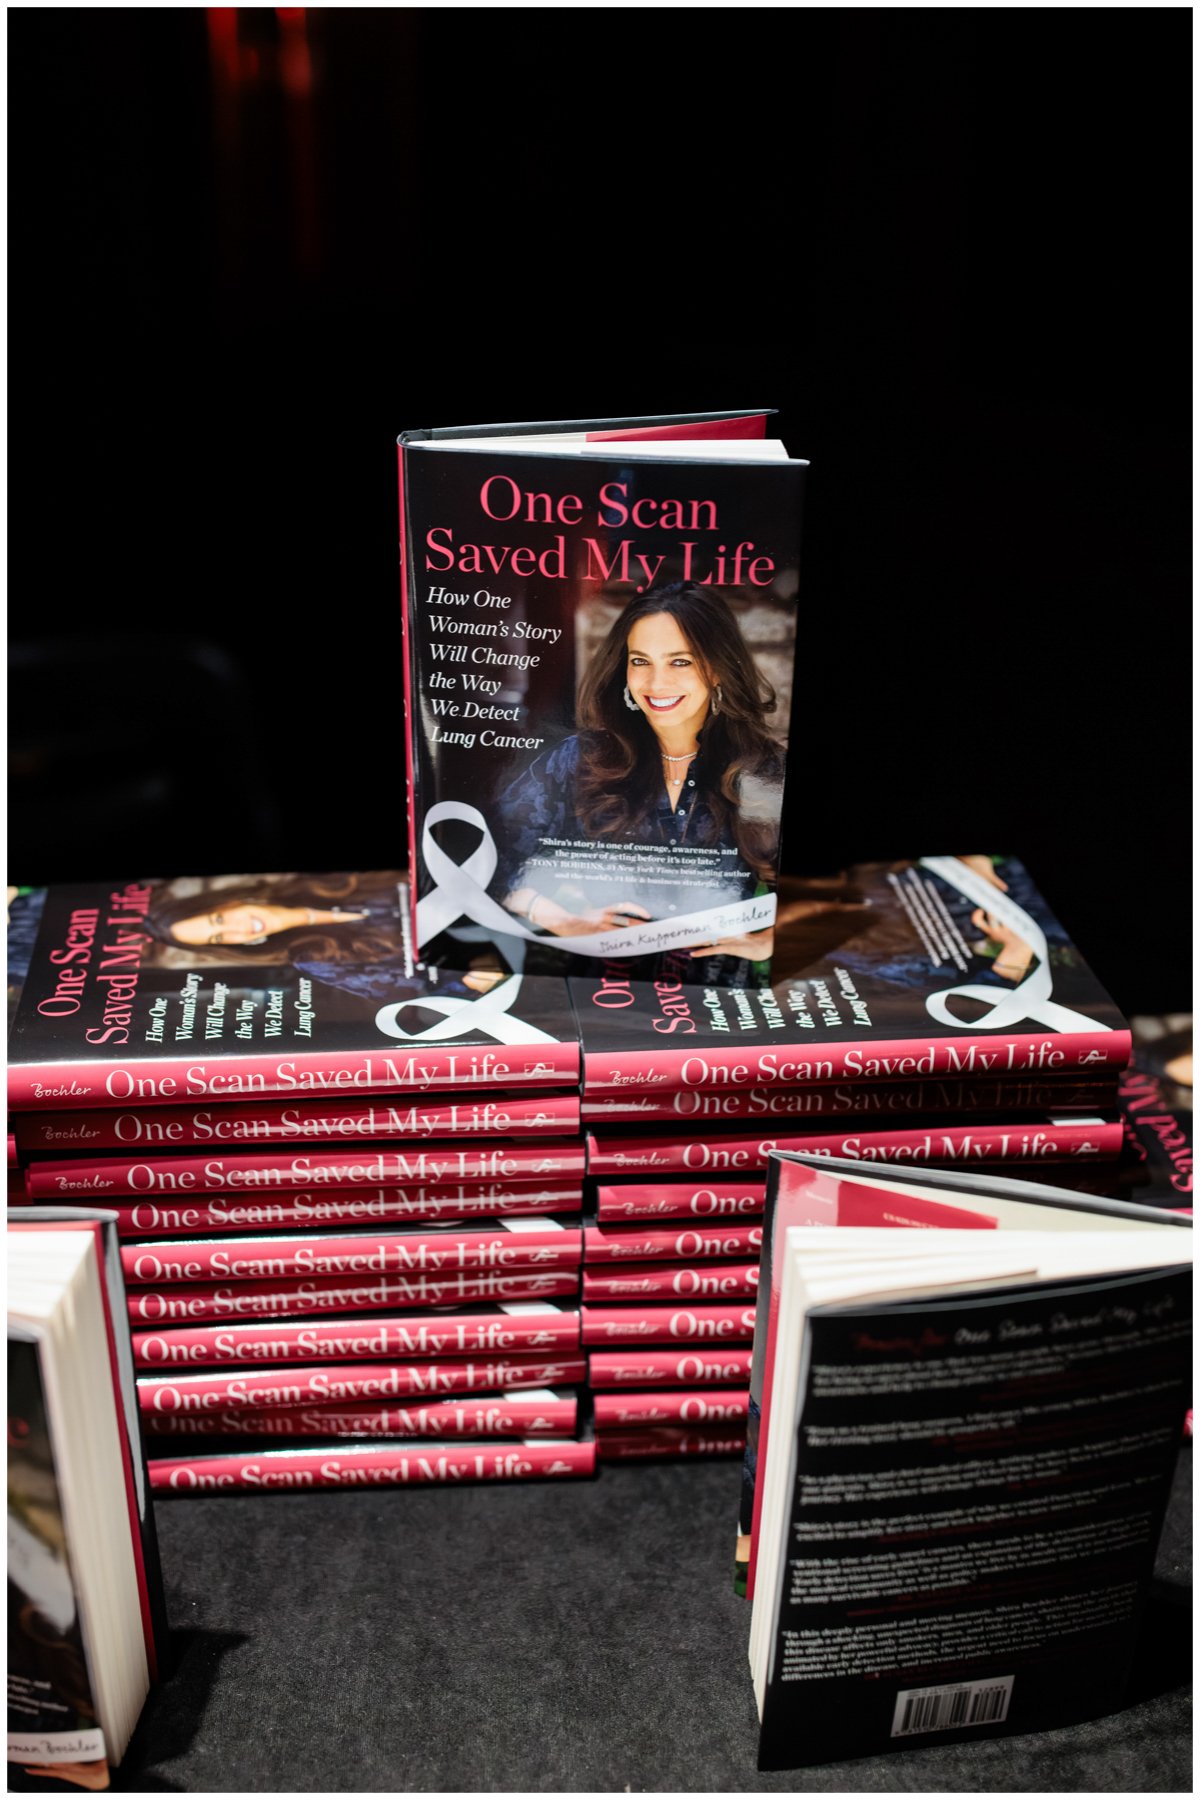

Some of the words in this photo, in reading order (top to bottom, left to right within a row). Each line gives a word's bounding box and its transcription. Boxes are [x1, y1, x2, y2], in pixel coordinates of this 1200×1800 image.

[480, 475, 583, 525] One
[598, 482, 719, 531] Scan
[425, 527, 567, 580] Saved
[582, 537, 666, 594] My
[682, 541, 777, 587] Life
[426, 587, 470, 606] How
[473, 590, 511, 609] One
[512, 621, 562, 644] Story
[429, 643, 467, 663] Will
[471, 646, 541, 669] Change
[428, 673, 456, 691] the
[461, 676, 501, 695] Way
[431, 699, 461, 717] We
[463, 703, 520, 722] Detect
[430, 727, 476, 749] Lung
[479, 731, 544, 750] Cancer
[555, 849, 569, 858] the
[570, 851, 598, 862] power
[598, 850, 609, 860] of
[609, 852, 637, 863] acting
[637, 853, 666, 864] before
[681, 856, 696, 865] too
[573, 840, 596, 850] story
[597, 841, 605, 849] is
[623, 842, 634, 851] of
[634, 844, 671, 855] courage,
[672, 847, 720, 856] awareness,
[721, 847, 738, 856] and
[723, 870, 752, 879] author
[107, 883, 152, 925] Life
[50, 908, 99, 965] Scan
[100, 929, 153, 969] My
[37, 968, 87, 1017] One
[180, 973, 203, 998] Story
[208, 983, 230, 1014] Change
[294, 978, 312, 1010] Cancer
[85, 973, 139, 1045] Saved
[149, 998, 167, 1017] One
[236, 1000, 257, 1023] Way
[266, 990, 284, 1019] Detect
[651, 980, 697, 1034] Save
[762, 1007, 786, 1030] Will
[146, 1018, 164, 1043] How
[205, 1015, 224, 1040] Will
[235, 1022, 251, 1039] the
[265, 1019, 282, 1038] We
[294, 1010, 316, 1038] Lung
[709, 1008, 730, 1032] How
[105, 1070, 176, 1098] One
[186, 1066, 265, 1096] Scan
[276, 1059, 372, 1091] Saved
[383, 1057, 439, 1090] My
[445, 1053, 509, 1083] Life
[681, 1057, 749, 1085] One
[757, 1054, 833, 1082] Scan
[843, 1047, 935, 1078] Saved
[946, 1045, 998, 1075] My
[1006, 1041, 1065, 1070] Life
[674, 1091, 740, 1115] One
[748, 1087, 823, 1113] Scan
[114, 1114, 183, 1142] One
[193, 1112, 272, 1139] Scan
[281, 1108, 375, 1137] Saved
[386, 1106, 440, 1137] My
[448, 1104, 511, 1132] Life
[683, 1143, 749, 1168] One
[842, 1136, 931, 1162] Saved
[1001, 1133, 1057, 1158] Life
[128, 1165, 195, 1190] One
[204, 1162, 281, 1188] Scan
[291, 1155, 384, 1184] Saved
[394, 1154, 449, 1184] My
[456, 1151, 517, 1178] Life
[131, 1203, 199, 1229] One
[207, 1199, 284, 1225] Scan
[293, 1190, 385, 1220] Saved
[396, 1188, 448, 1217] My
[457, 1184, 516, 1211] Life
[690, 1190, 755, 1215] One
[676, 1232, 740, 1256] One
[134, 1255, 202, 1279] One
[209, 1252, 285, 1277] Scan
[294, 1245, 386, 1273] Saved
[395, 1244, 448, 1271] My
[456, 1240, 516, 1266] Life
[139, 1294, 206, 1319] One
[213, 1289, 289, 1314] Scan
[297, 1278, 388, 1309] Saved
[399, 1275, 449, 1303] My
[457, 1271, 515, 1297] Life
[672, 1269, 738, 1295] One
[669, 1311, 734, 1337] One
[141, 1336, 207, 1361] One
[214, 1334, 289, 1359] Scan
[297, 1328, 388, 1356] Saved
[397, 1327, 448, 1355] My
[456, 1323, 514, 1349] Life
[154, 1386, 219, 1412] One
[226, 1381, 300, 1406] Scan
[309, 1368, 399, 1400] Saved
[408, 1366, 459, 1393] My
[467, 1362, 523, 1388] Life
[170, 1468, 234, 1489] One
[241, 1465, 313, 1487] Scan
[321, 1458, 409, 1486] Saved
[475, 1454, 532, 1478] Life
